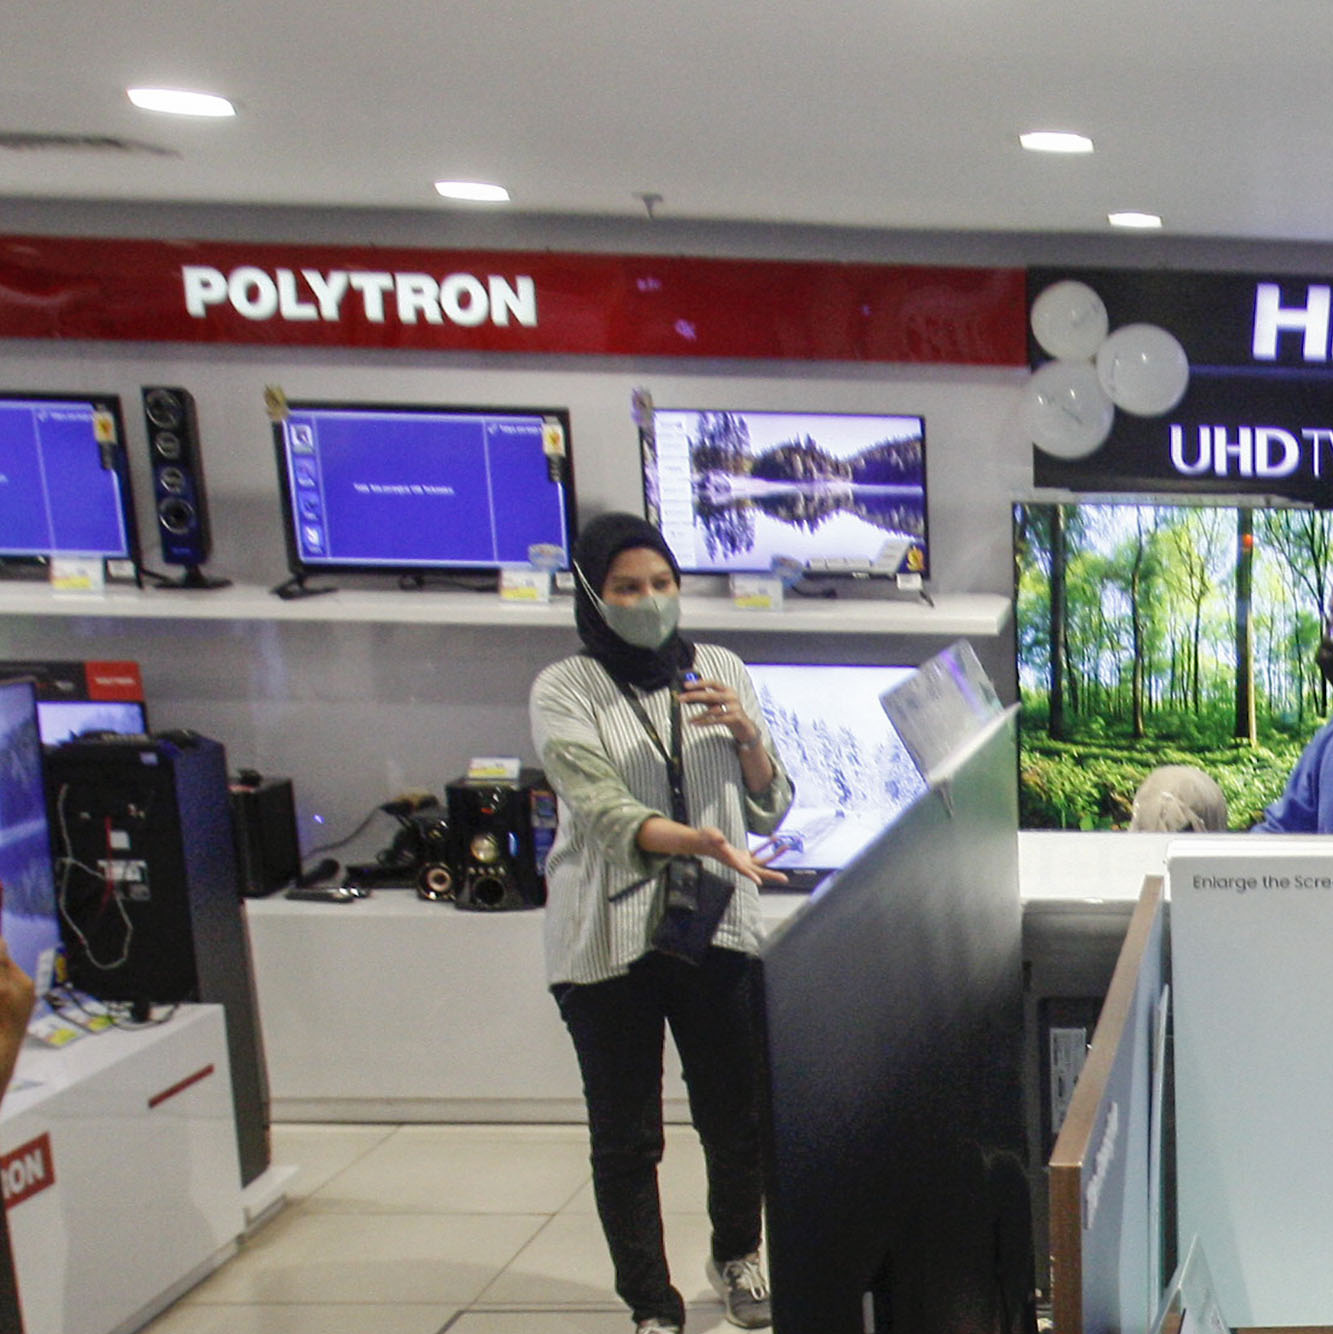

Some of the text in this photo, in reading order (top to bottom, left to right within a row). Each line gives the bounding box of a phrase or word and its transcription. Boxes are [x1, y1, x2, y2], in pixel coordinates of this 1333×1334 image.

[183, 265, 537, 326] POLYTRON
[1193, 874, 1257, 892] Enlarge
[1263, 874, 1290, 888] the
